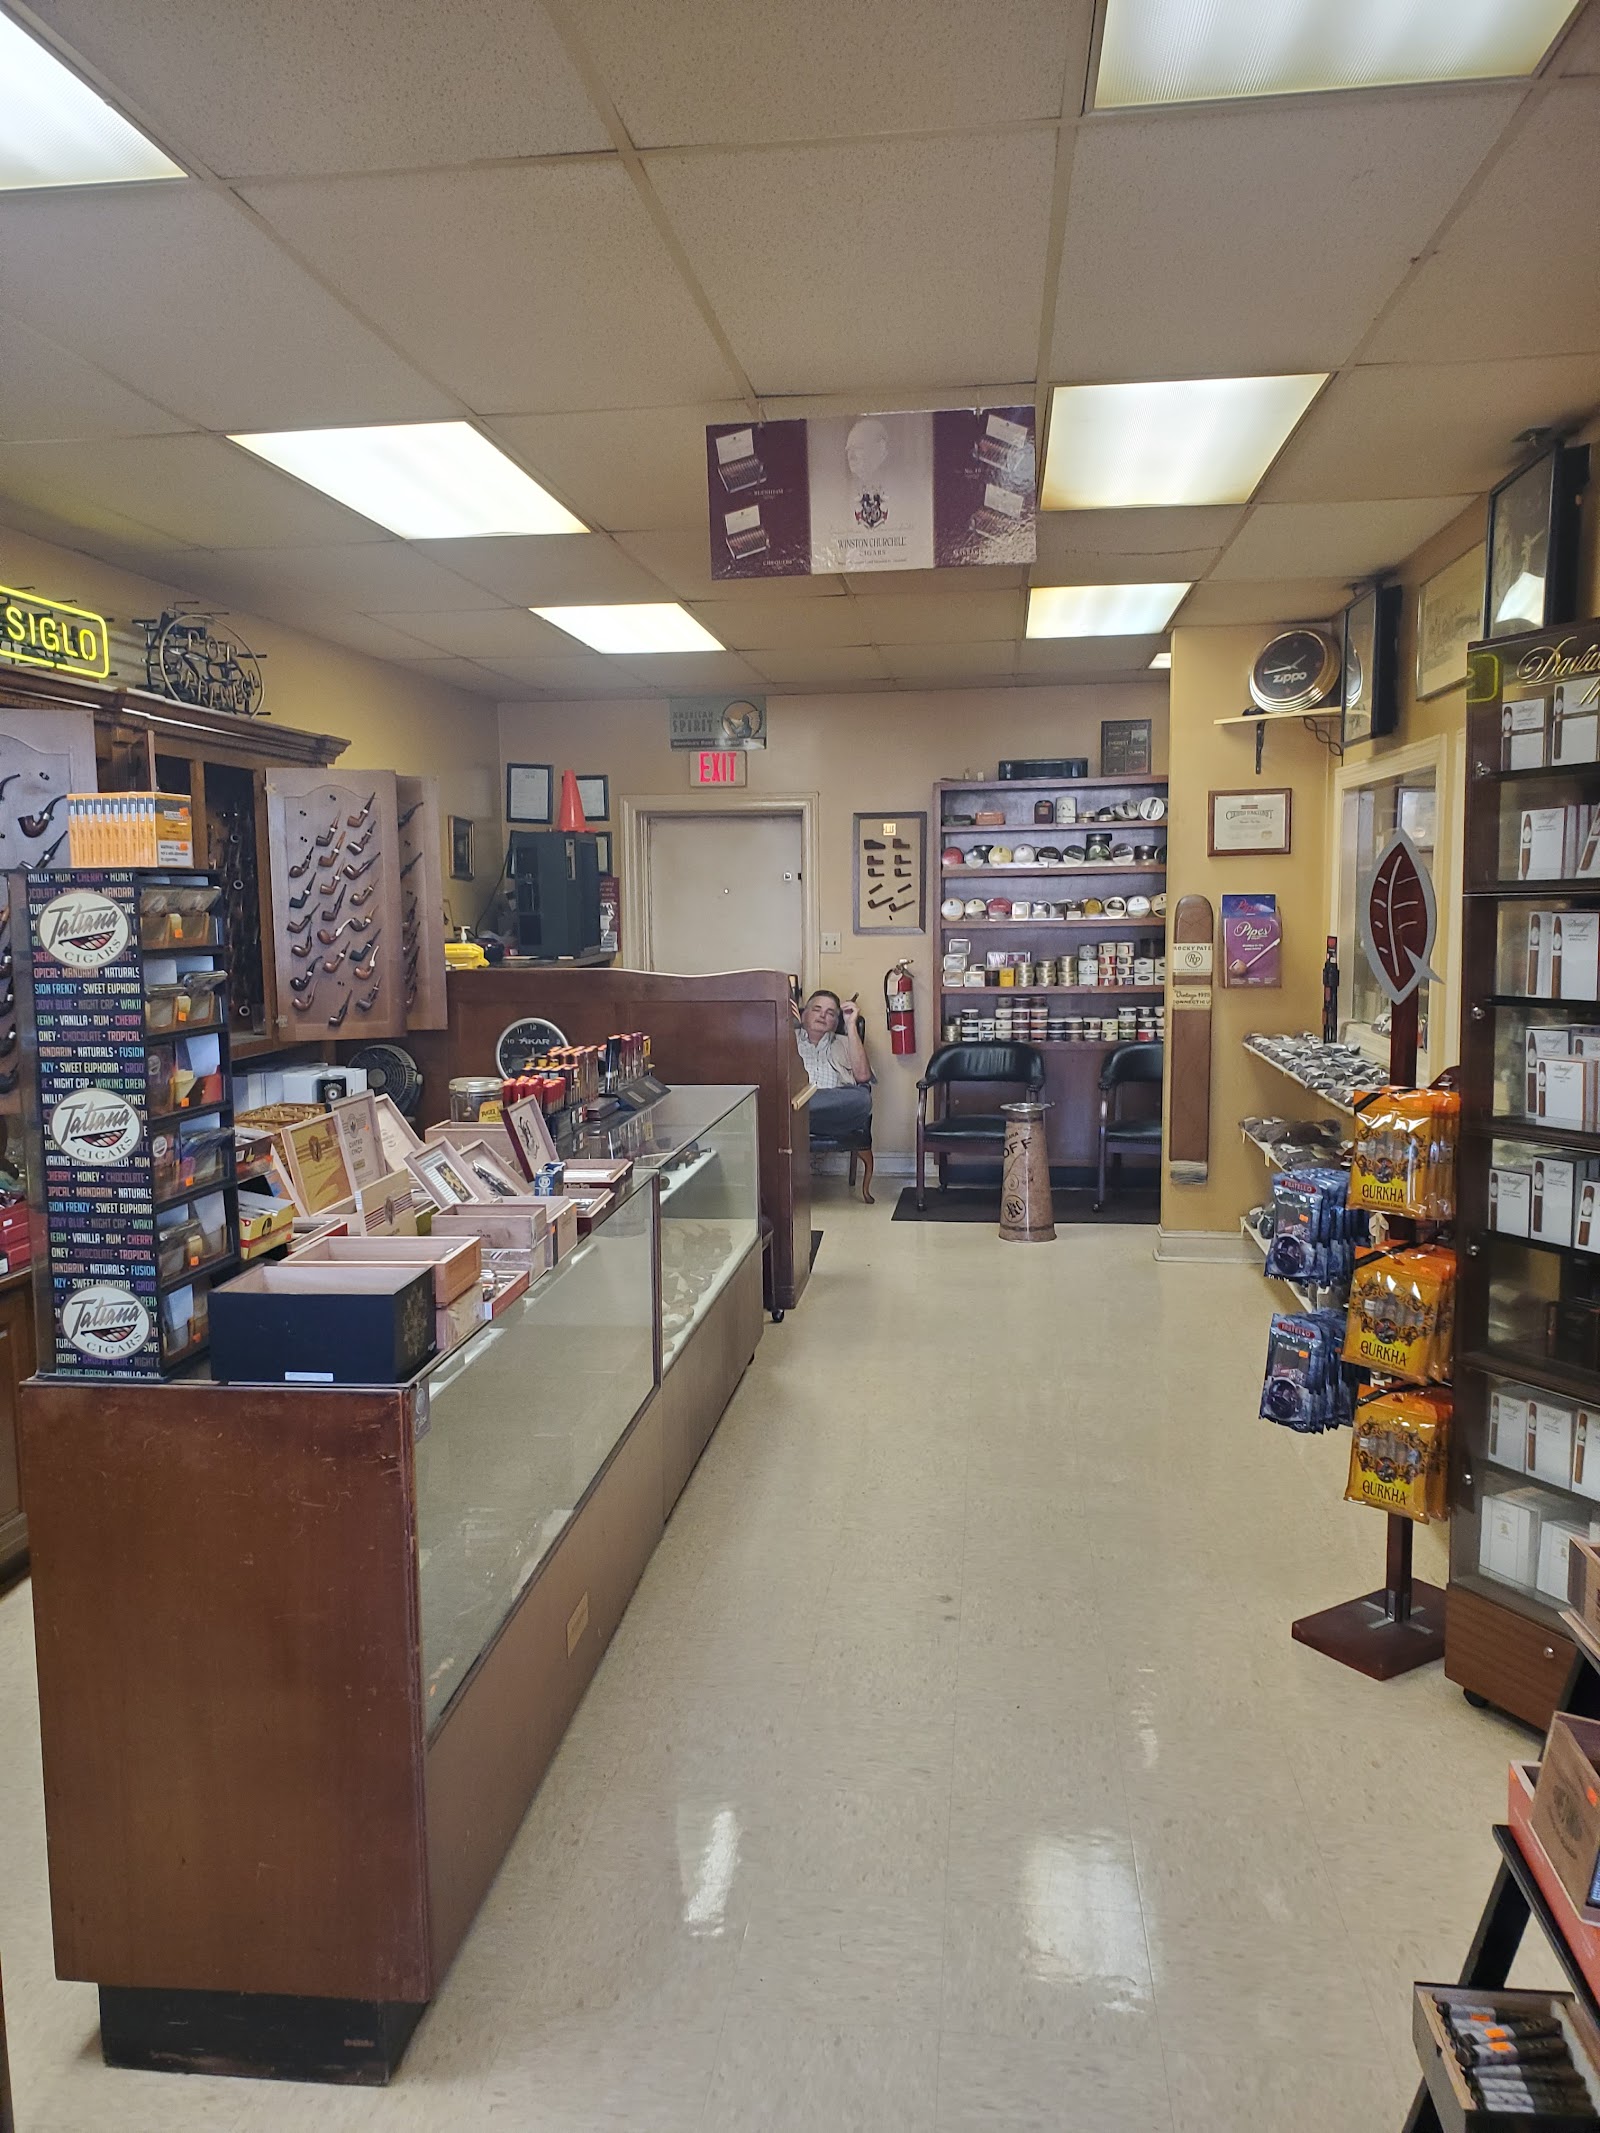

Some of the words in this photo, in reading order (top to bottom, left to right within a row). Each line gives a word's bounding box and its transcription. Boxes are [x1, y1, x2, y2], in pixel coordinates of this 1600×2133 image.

[837, 538, 868, 550] WINSTON
[869, 536, 907, 548] CHURCHILL
[859, 549, 886, 557] CIGARS
[5, 606, 97, 661] SIGLO
[672, 719, 713, 733] SPIRIT
[699, 752, 737, 783] EXIT
[48, 903, 121, 950] Tatiana
[1234, 921, 1272, 941] Pipes
[64, 939, 121, 964] CIGARS
[104, 967, 140, 978] NATURALS
[52, 984, 77, 994] FRENZY
[83, 983, 106, 994] SWEET
[78, 1000, 98, 1010] NIGHT
[100, 1000, 114, 1010] CAP
[60, 1015, 88, 1026] VANILLA
[94, 1015, 110, 1026] RUM
[115, 1015, 142, 1026] CHERRY
[62, 1031, 102, 1042] CHOCOLATE
[106, 1031, 140, 1042] TROPICAL
[78, 1046, 114, 1058] NATURALS
[120, 1046, 144, 1058] FUSION
[60, 1062, 82, 1073] SWEET
[84, 1062, 119, 1073] EUPHORIA
[54, 1078, 74, 1089] NIGHT
[76, 1078, 90, 1089] CAP
[95, 1078, 124, 1089] WAKING
[60, 1101, 132, 1146] Tatiana
[76, 1136, 132, 1160] CIGARS
[134, 1157, 150, 1168] RUM
[76, 1171, 100, 1182] HONEY
[106, 1172, 145, 1183] CHOCOLATE
[76, 1187, 112, 1198] MANDARIN
[1362, 1184, 1404, 1203] GURKHA
[66, 1202, 90, 1212] FRENZY
[96, 1203, 118, 1214] SWEET
[90, 1218, 111, 1228] NIGHT
[113, 1218, 127, 1229] CAP
[72, 1232, 100, 1244] VANILLA
[106, 1234, 122, 1244] RUM
[127, 1234, 153, 1245] CHERRY
[74, 1248, 114, 1260] CHOCOLATE
[119, 1250, 152, 1260] TROPICAL
[90, 1264, 125, 1276] NATURALS
[131, 1265, 156, 1276] FUSION
[69, 1297, 142, 1341] Tatiana
[86, 1332, 142, 1354] CIGARS
[1360, 1340, 1407, 1366] GURKHA
[134, 1357, 154, 1368] NIGHT
[1362, 1480, 1406, 1505] GURKHA
